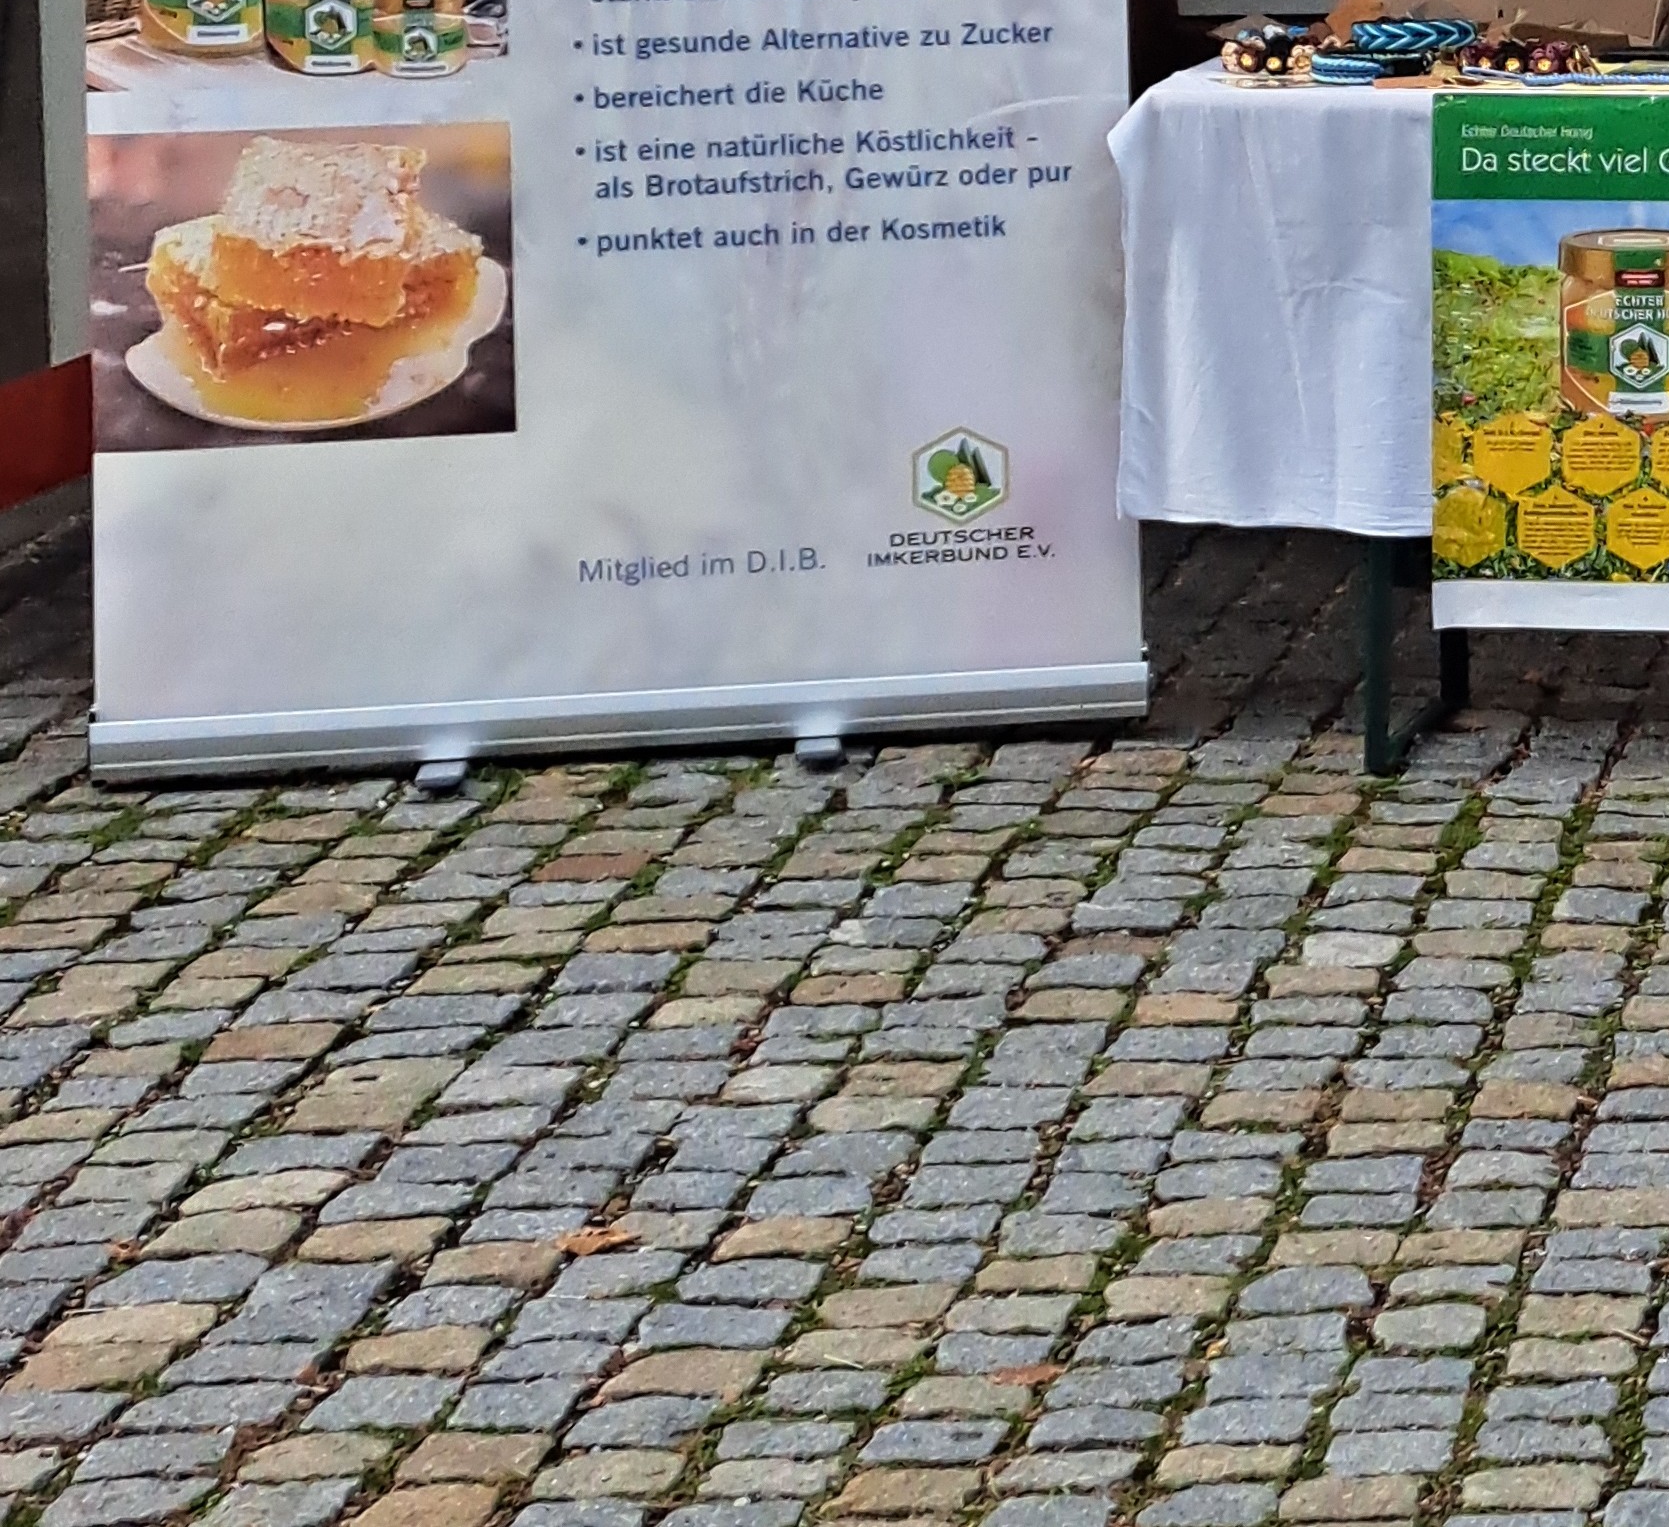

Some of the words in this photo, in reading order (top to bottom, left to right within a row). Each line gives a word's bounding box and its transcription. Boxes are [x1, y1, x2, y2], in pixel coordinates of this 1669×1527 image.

[592, 33, 626, 56] ist
[635, 29, 751, 60] gesunde
[761, 25, 910, 51] Alternative
[920, 29, 951, 47] zu
[961, 21, 1054, 46] Zucker
[593, 83, 735, 110] bereichert
[744, 80, 786, 104] die
[797, 78, 884, 103] Küche
[1462, 148, 1497, 172] Da
[1507, 147, 1591, 173] steckt
[1599, 148, 1648, 173] viel
[597, 226, 703, 258] punktet
[713, 223, 780, 248] auch
[791, 221, 816, 245] in
[826, 219, 871, 243] der
[881, 214, 1006, 241] Kosmetik
[889, 526, 1035, 548] DEUTSCHER
[579, 554, 690, 587] Mitglied
[701, 552, 735, 576] im
[747, 547, 826, 574] D.I.B.
[867, 546, 1009, 567] IMKERBUND
[1016, 544, 1056, 559] E.V.
